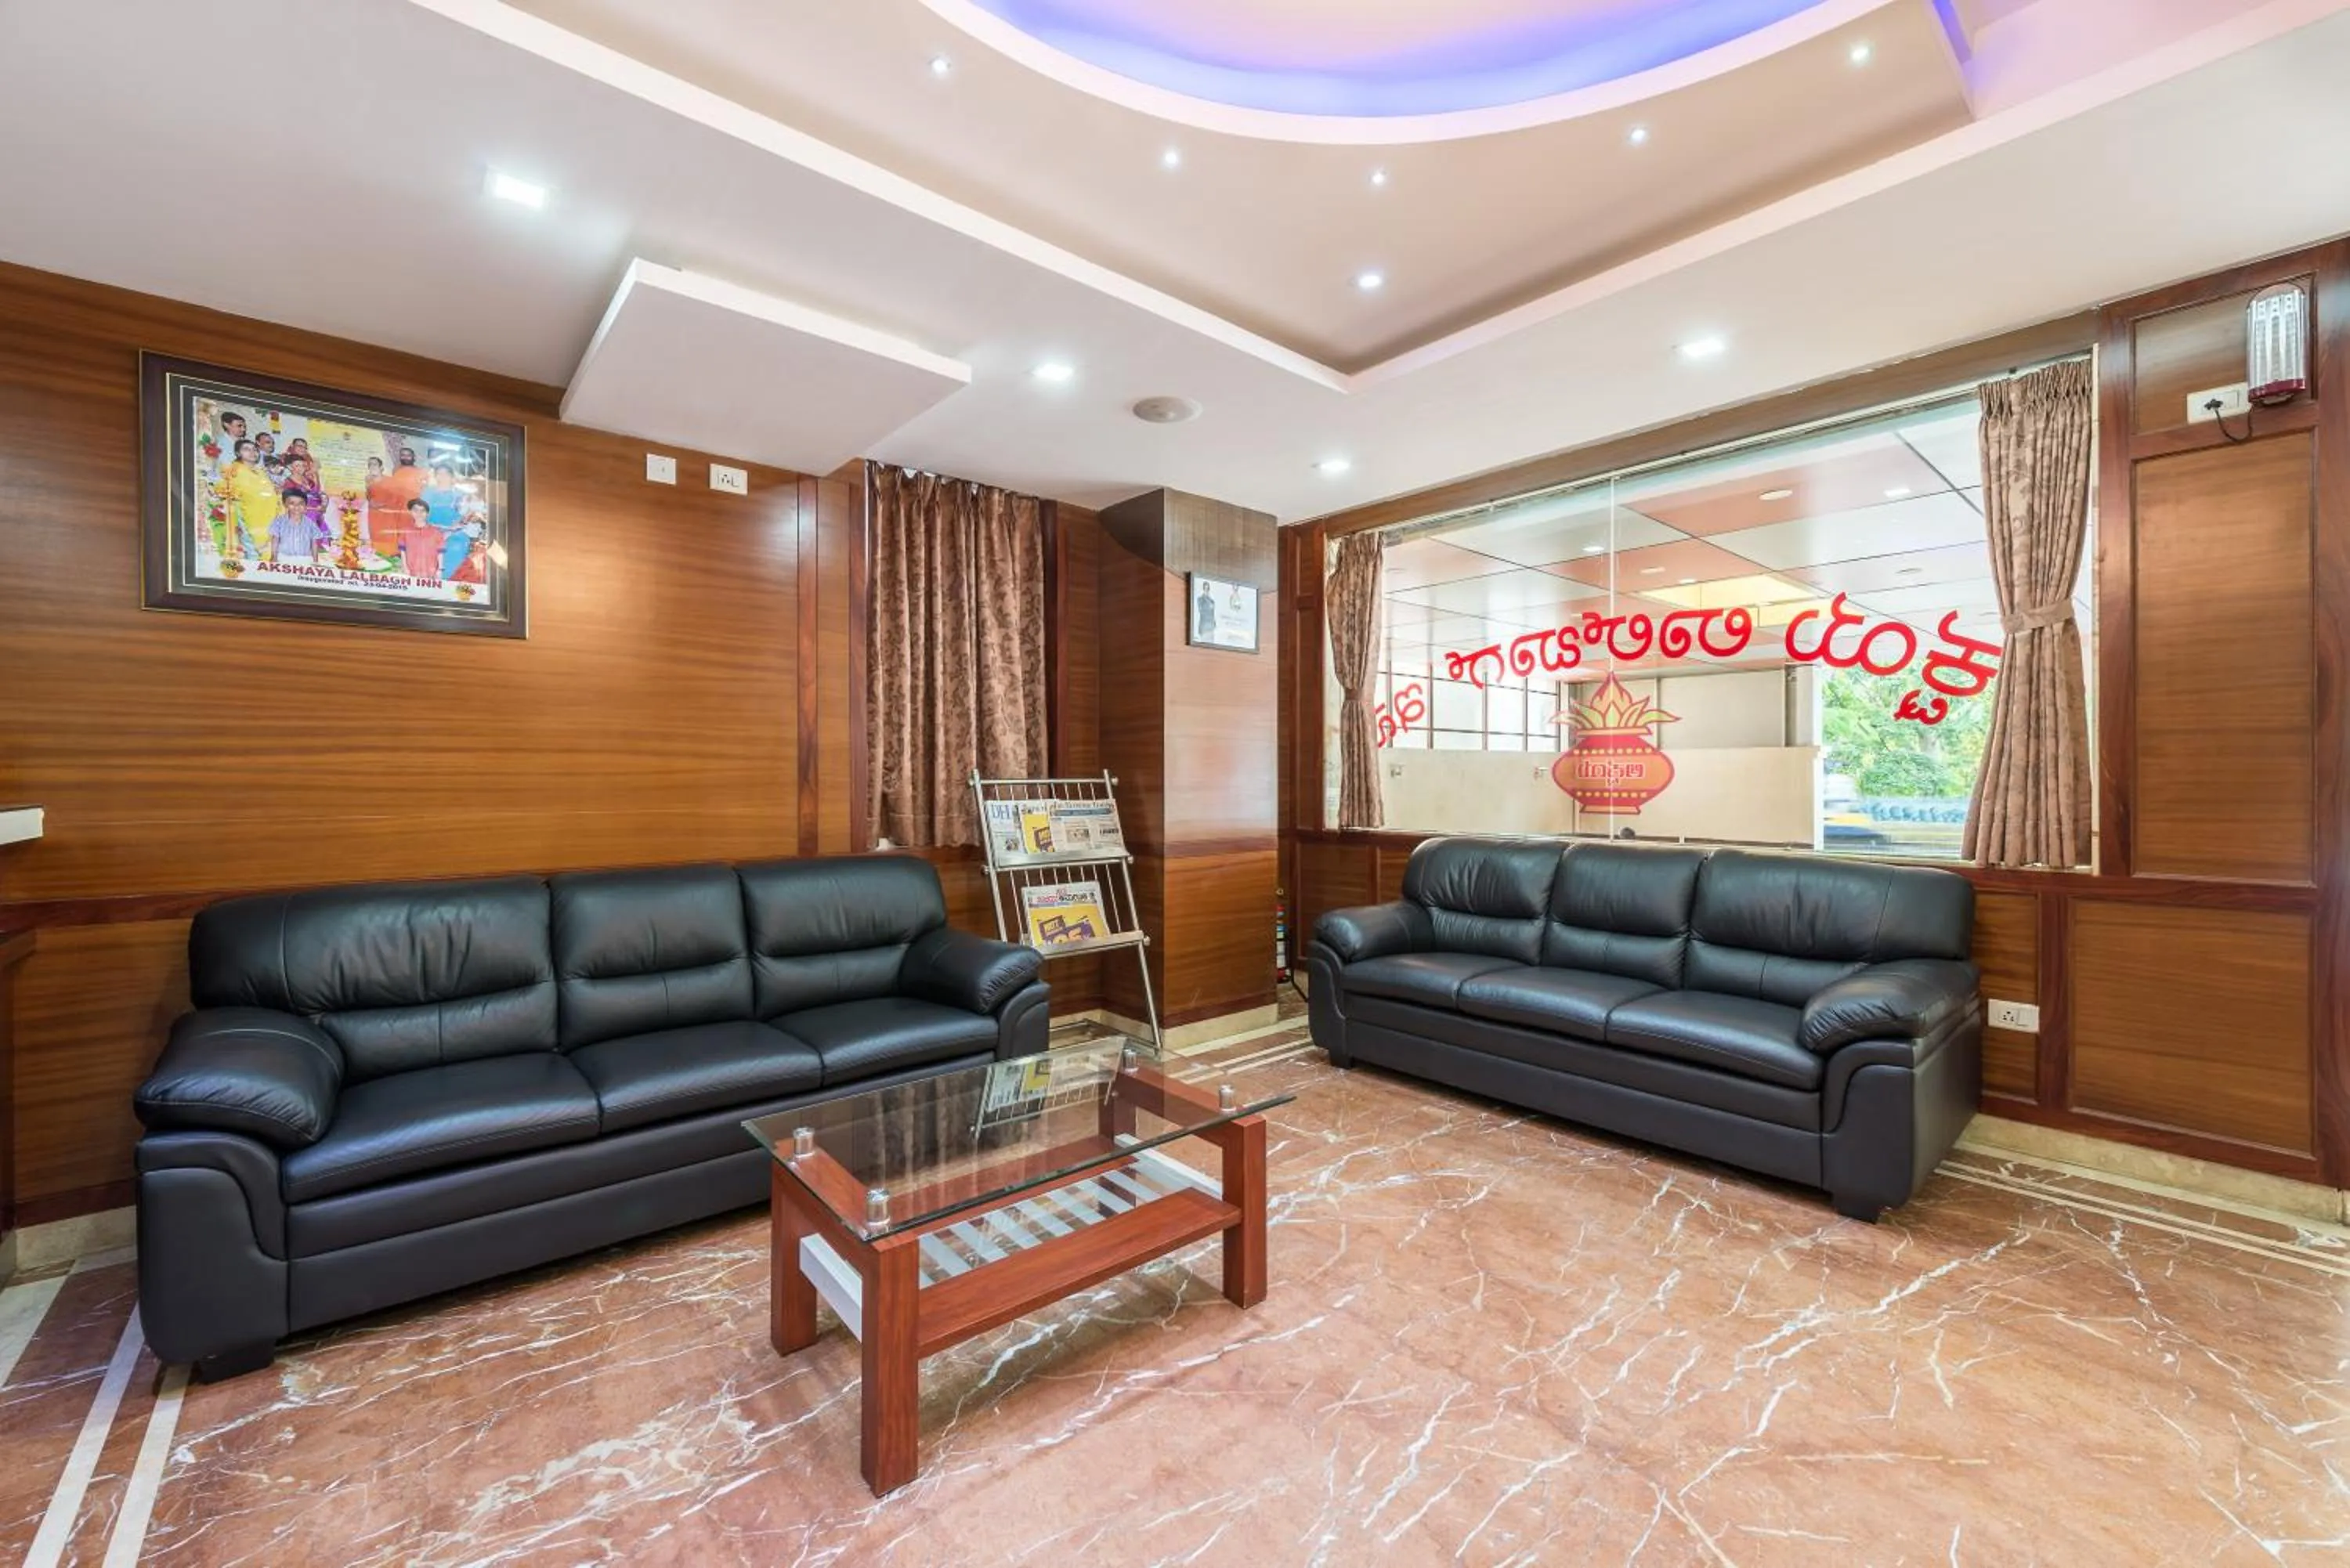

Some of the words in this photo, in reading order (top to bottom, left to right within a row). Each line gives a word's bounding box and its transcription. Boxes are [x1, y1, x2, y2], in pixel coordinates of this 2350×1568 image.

[256, 561, 335, 579] AKSHAYA
[340, 569, 411, 586] LALBAGH
[416, 578, 443, 589] INN
